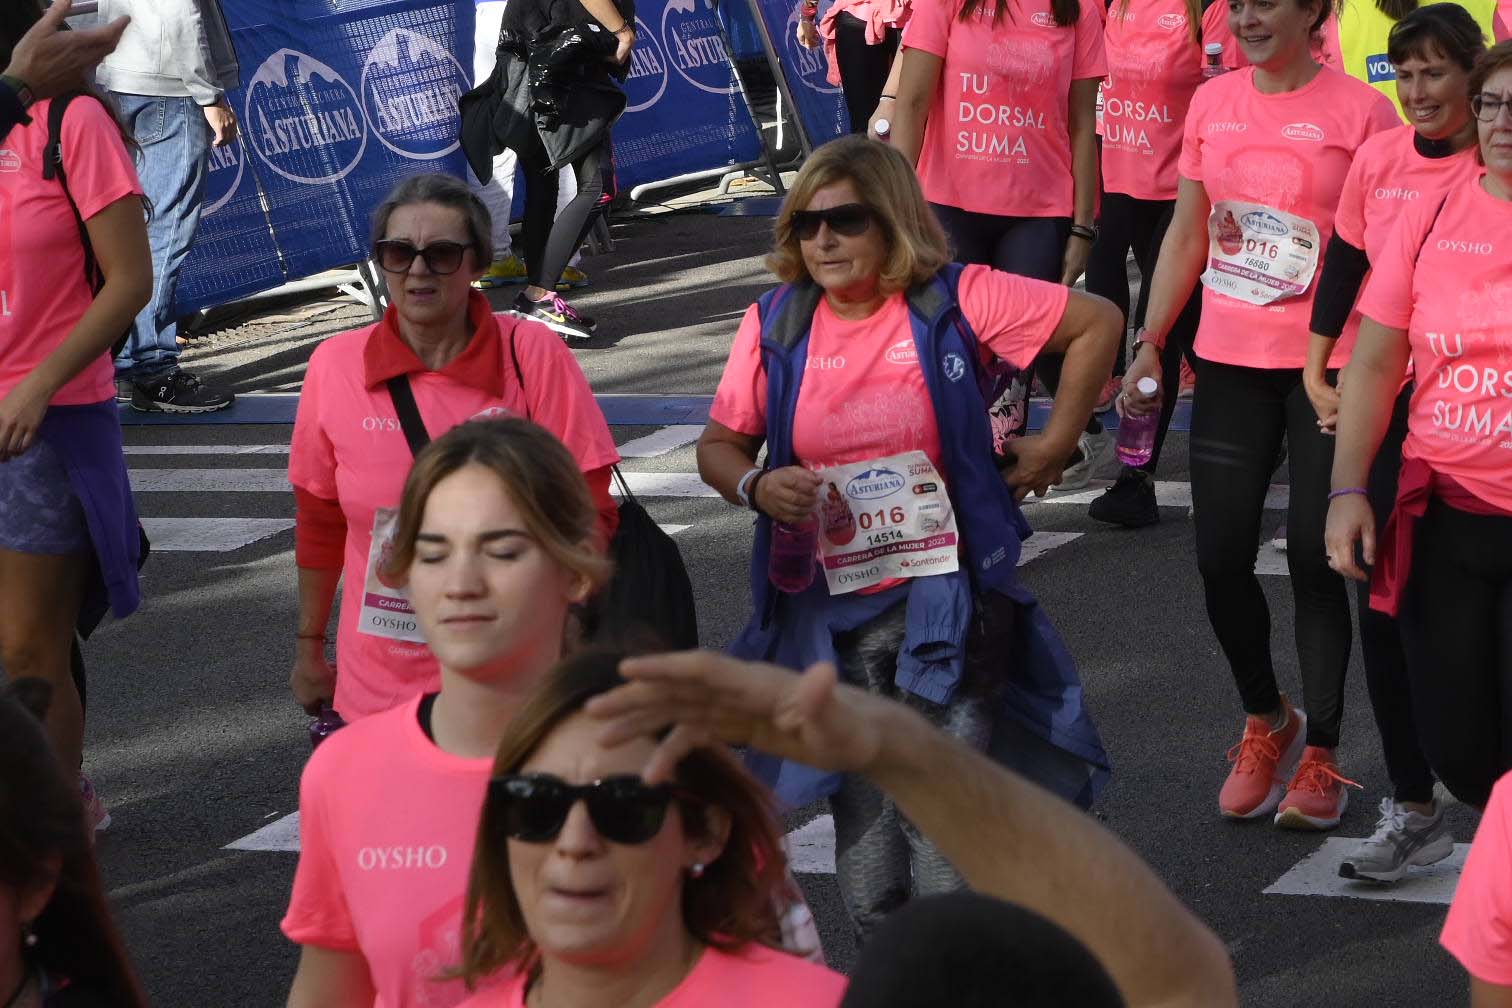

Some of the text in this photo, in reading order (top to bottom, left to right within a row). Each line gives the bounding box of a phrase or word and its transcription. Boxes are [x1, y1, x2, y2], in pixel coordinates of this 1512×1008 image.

[959, 72, 989, 95] TU
[958, 101, 1046, 130] DORSAL
[1103, 97, 1173, 123] ORSAL
[259, 103, 361, 156] ASTURIANA
[1102, 123, 1152, 148] UMA
[957, 130, 1028, 156] SUMA
[1246, 238, 1279, 259] 016
[1437, 239, 1493, 255] OYSHO
[1425, 332, 1464, 358] TU
[850, 478, 901, 496] ASTURIANA
[859, 506, 905, 530] 016
[866, 530, 904, 546] 14514
[837, 552, 873, 565] CARRERA
[898, 542, 925, 551] MUJER
[928, 538, 946, 548] 2023
[838, 566, 880, 585] OYSHO
[372, 615, 417, 632] OYSHO
[358, 845, 447, 871] OYSHO
